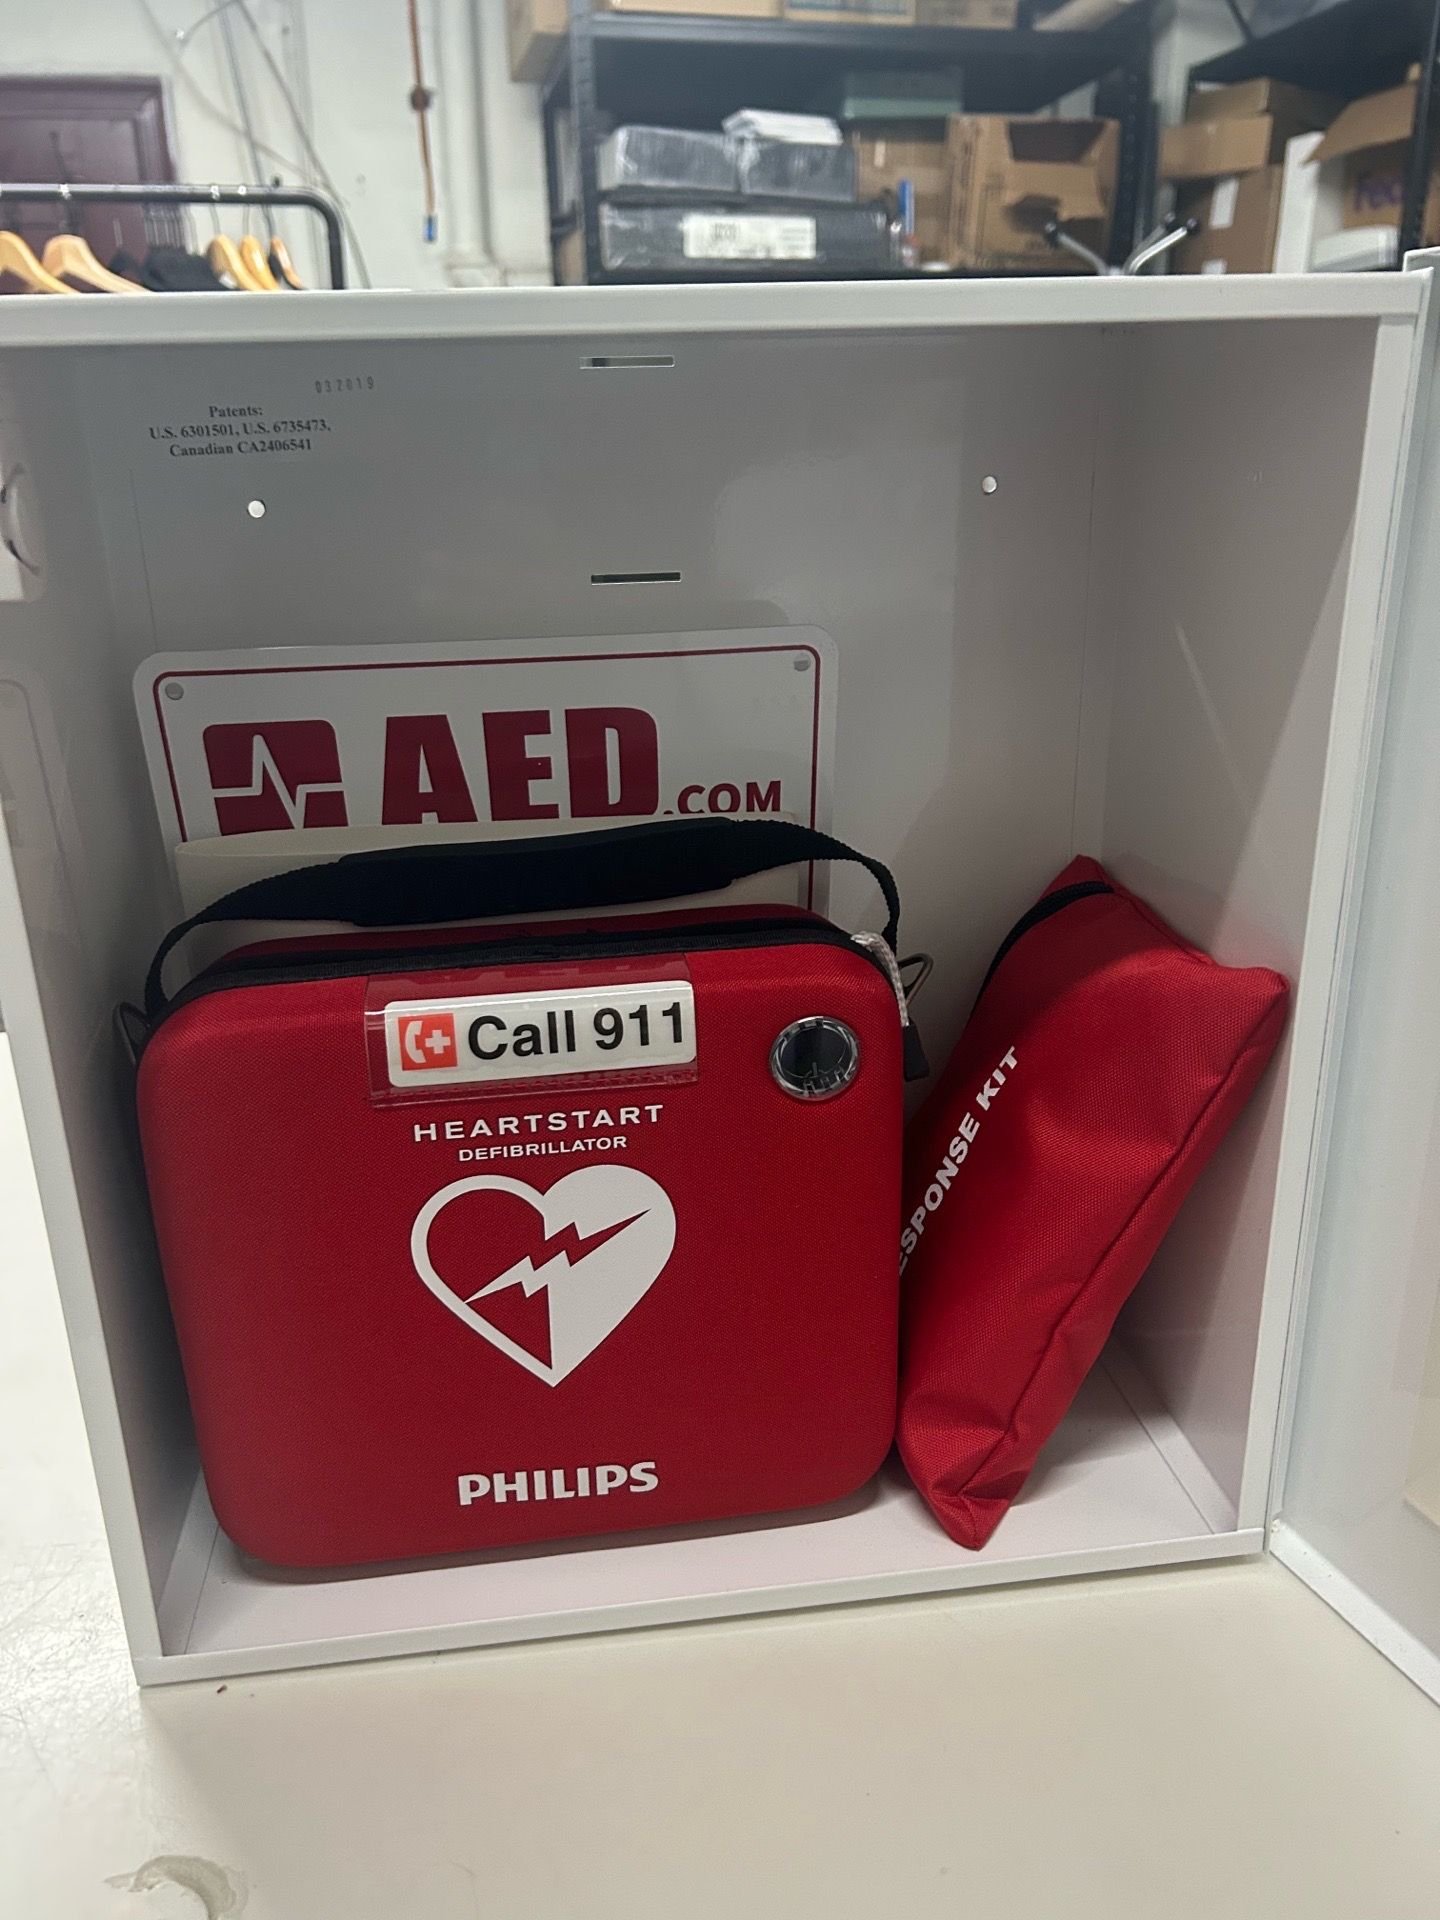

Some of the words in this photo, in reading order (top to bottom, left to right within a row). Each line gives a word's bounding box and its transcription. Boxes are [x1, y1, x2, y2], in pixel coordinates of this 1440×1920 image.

[208, 405, 263, 418] Patents:
[149, 426, 177, 440] U.S.
[181, 424, 240, 439] 6301501,
[243, 422, 270, 436] U.S.
[273, 419, 332, 435] 6735473,
[169, 442, 234, 458] Canadian
[237, 438, 312, 454] CA2406541
[467, 1009, 577, 1061] Call
[593, 1001, 683, 1051] 911
[976, 1045, 1018, 1111] KIT
[413, 1104, 664, 1143] HEARTSTART
[458, 1136, 627, 1162] DEFIBRILLATOR
[457, 1461, 659, 1506] PHILIPS
